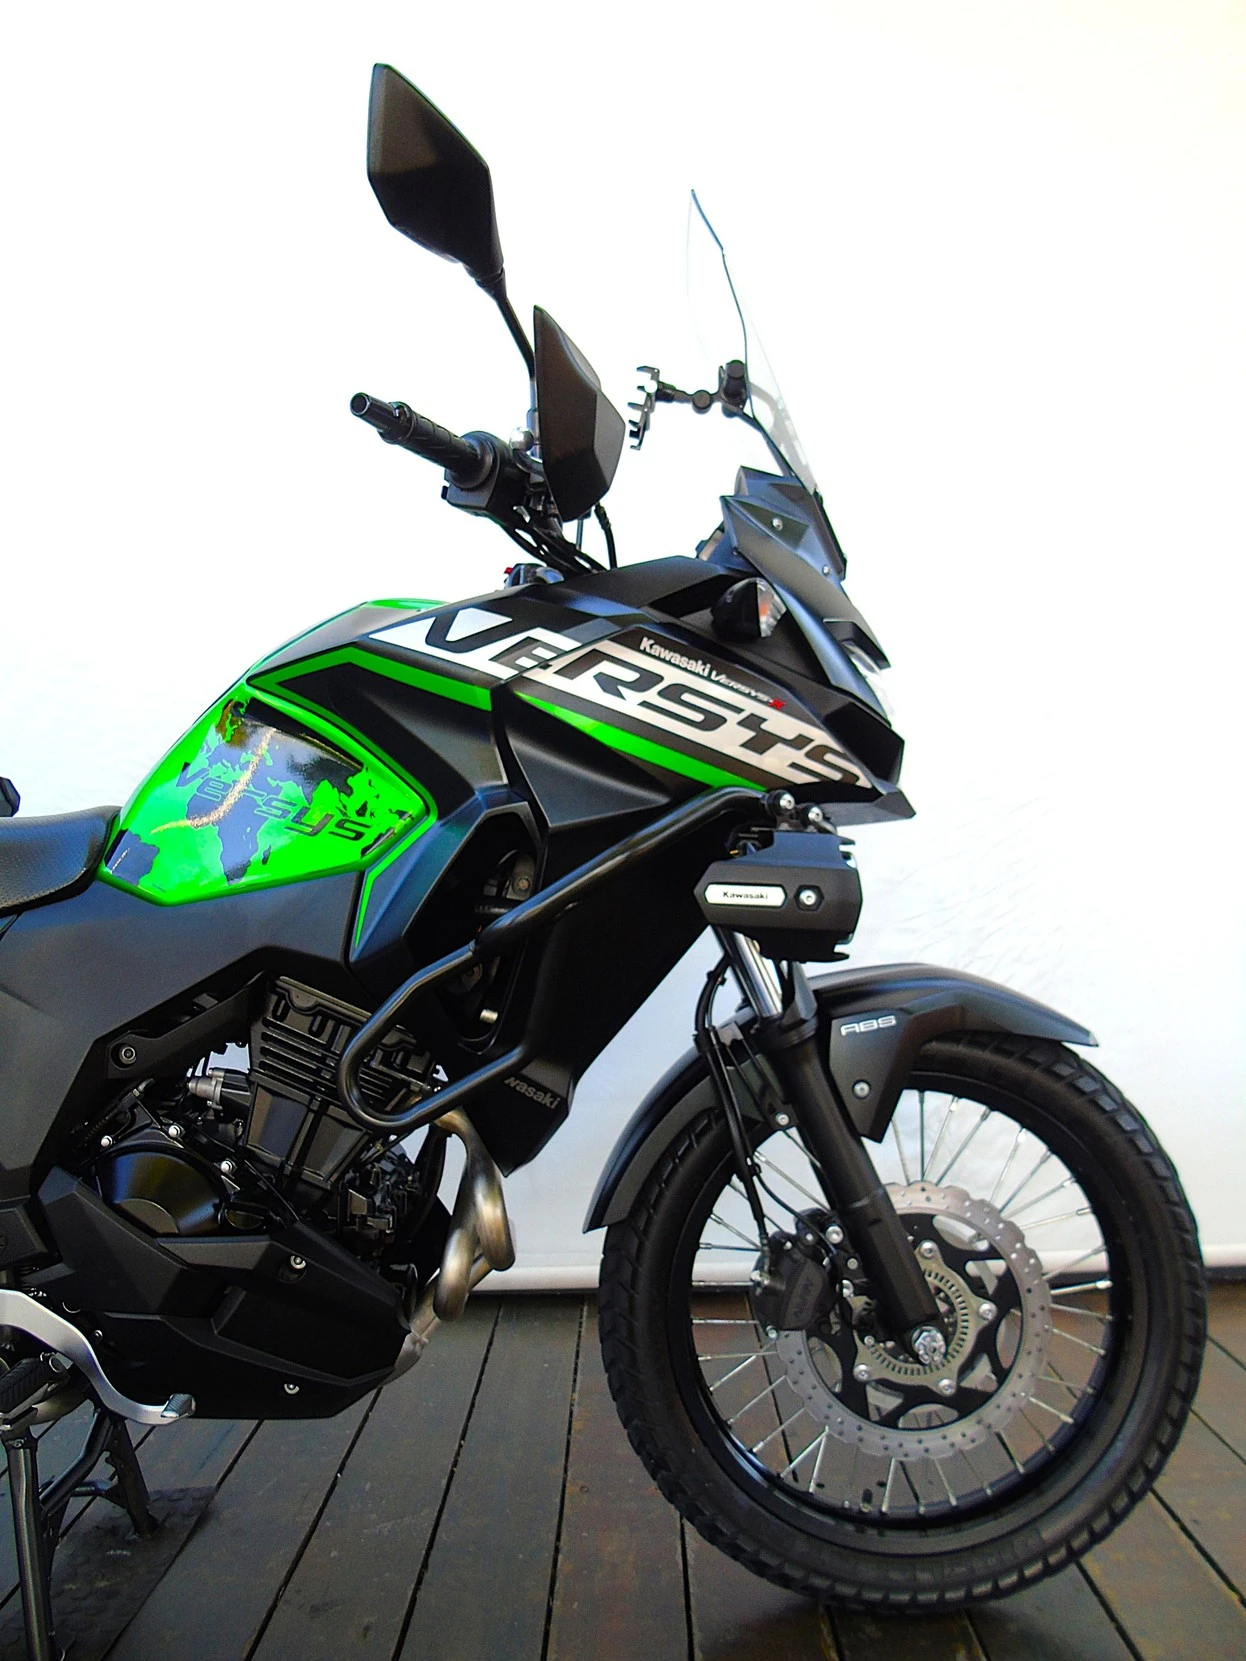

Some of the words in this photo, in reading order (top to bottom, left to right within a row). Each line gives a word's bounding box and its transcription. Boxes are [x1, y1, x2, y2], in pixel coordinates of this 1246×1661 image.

[639, 636, 711, 677] Kawasaki
[426, 606, 863, 786] VERSYS
[722, 890, 768, 900] Kawasaki
[840, 1015, 897, 1036] ABS
